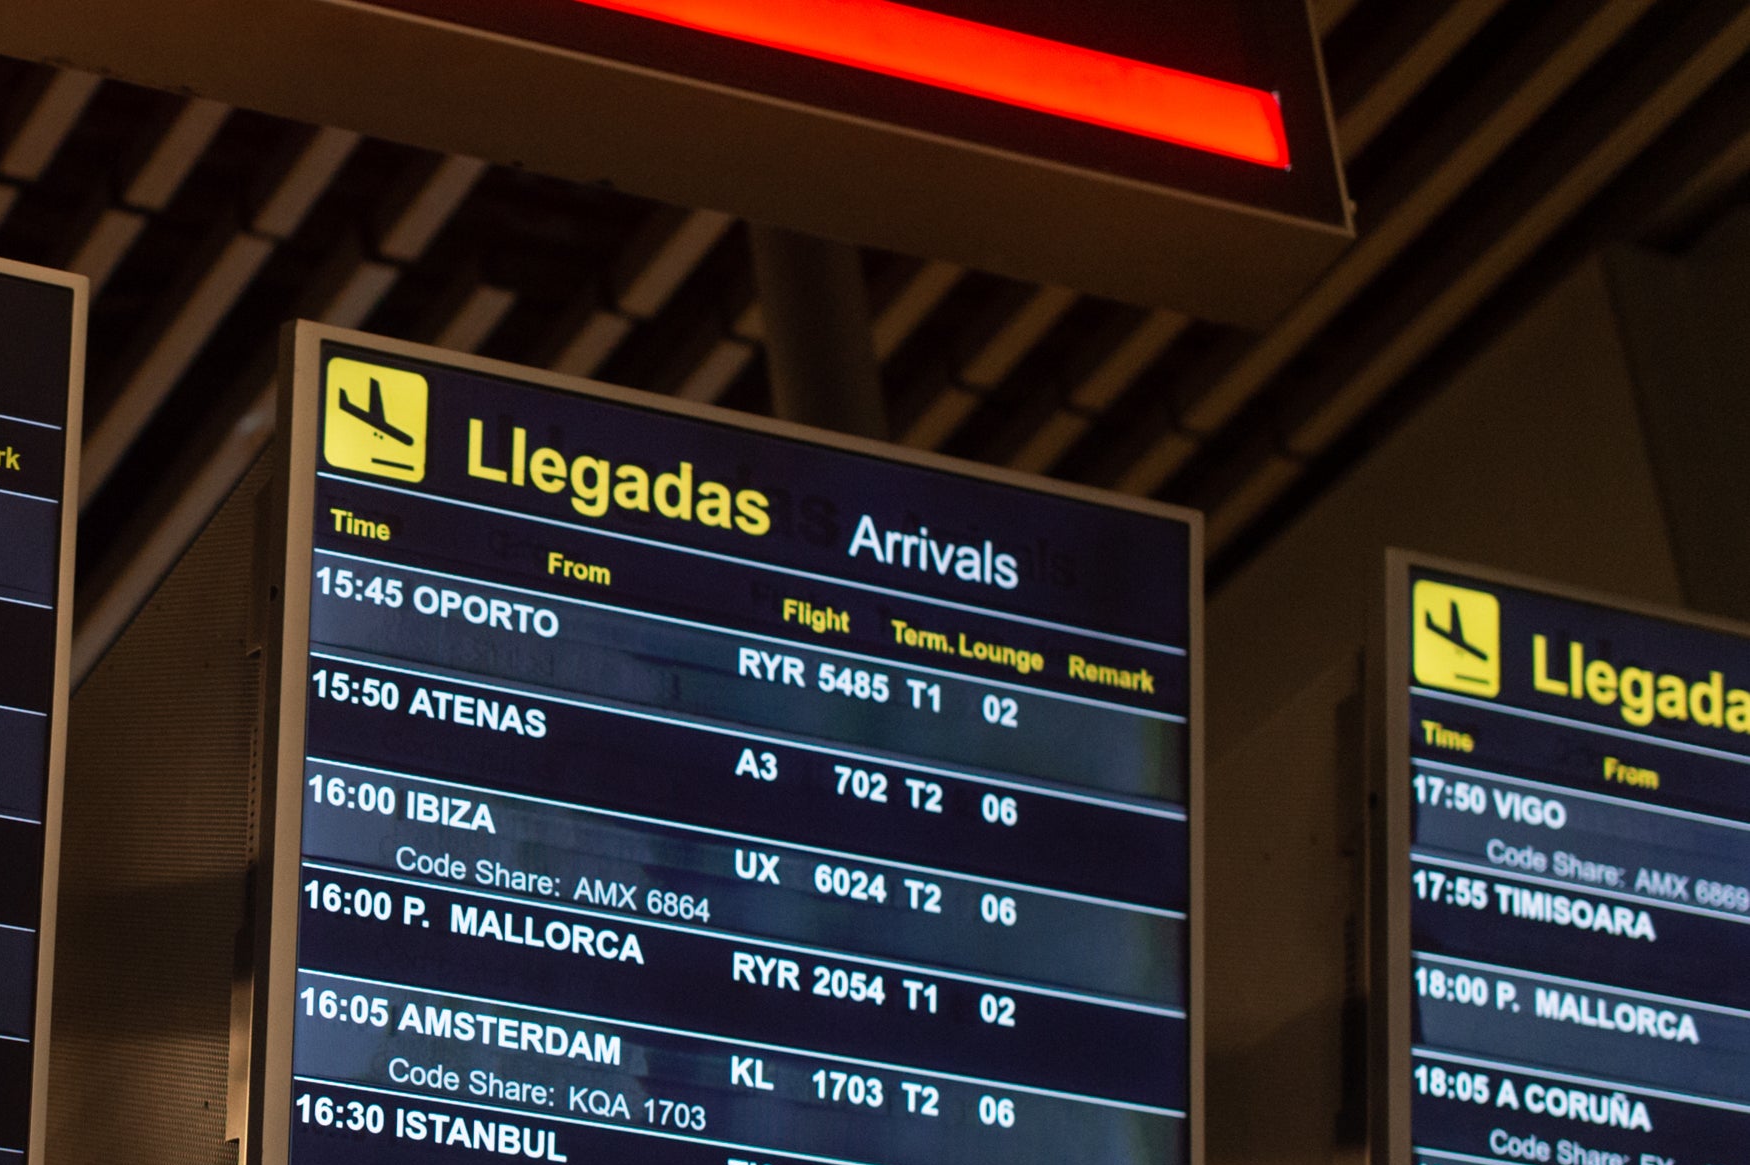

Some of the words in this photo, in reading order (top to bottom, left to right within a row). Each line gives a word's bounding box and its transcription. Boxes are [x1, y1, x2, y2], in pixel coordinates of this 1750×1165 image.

[467, 418, 771, 536] Llegadas
[848, 514, 1019, 589] Arrivals
[329, 508, 391, 542] Time
[547, 551, 611, 586] From
[783, 598, 850, 634] Flight
[891, 619, 955, 654] Term.
[958, 633, 1045, 674] Lounge
[1068, 655, 1154, 694] Remark
[316, 566, 404, 608] 15:45
[413, 585, 559, 638] OPORTO
[738, 647, 806, 688] RYR
[818, 662, 890, 703] 5485
[906, 678, 941, 713] T1
[982, 694, 1018, 728] 02
[1421, 719, 1475, 753] Time
[1603, 756, 1660, 790] From
[1413, 774, 1487, 815] 17:50
[1492, 788, 1567, 830] VIGO
[308, 773, 396, 816] 16:00
[406, 790, 497, 835] IBIZA
[735, 848, 780, 885] UX
[814, 863, 887, 904] 6024
[903, 878, 942, 914] T2
[981, 893, 1017, 926] 06
[395, 846, 467, 880] Code
[474, 859, 561, 897] Share:
[573, 876, 637, 911] AMX
[646, 889, 711, 923] 6864
[1413, 869, 1489, 910] 17:55
[1493, 883, 1657, 942] TIMISOARA
[1415, 966, 1489, 1007] 18:00
[1496, 980, 1521, 1013] P.
[1535, 987, 1699, 1044] MALLORCA
[1413, 1063, 1490, 1105] 18:05
[1495, 1078, 1521, 1110] A
[1525, 1086, 1653, 1132] CORUÑA
